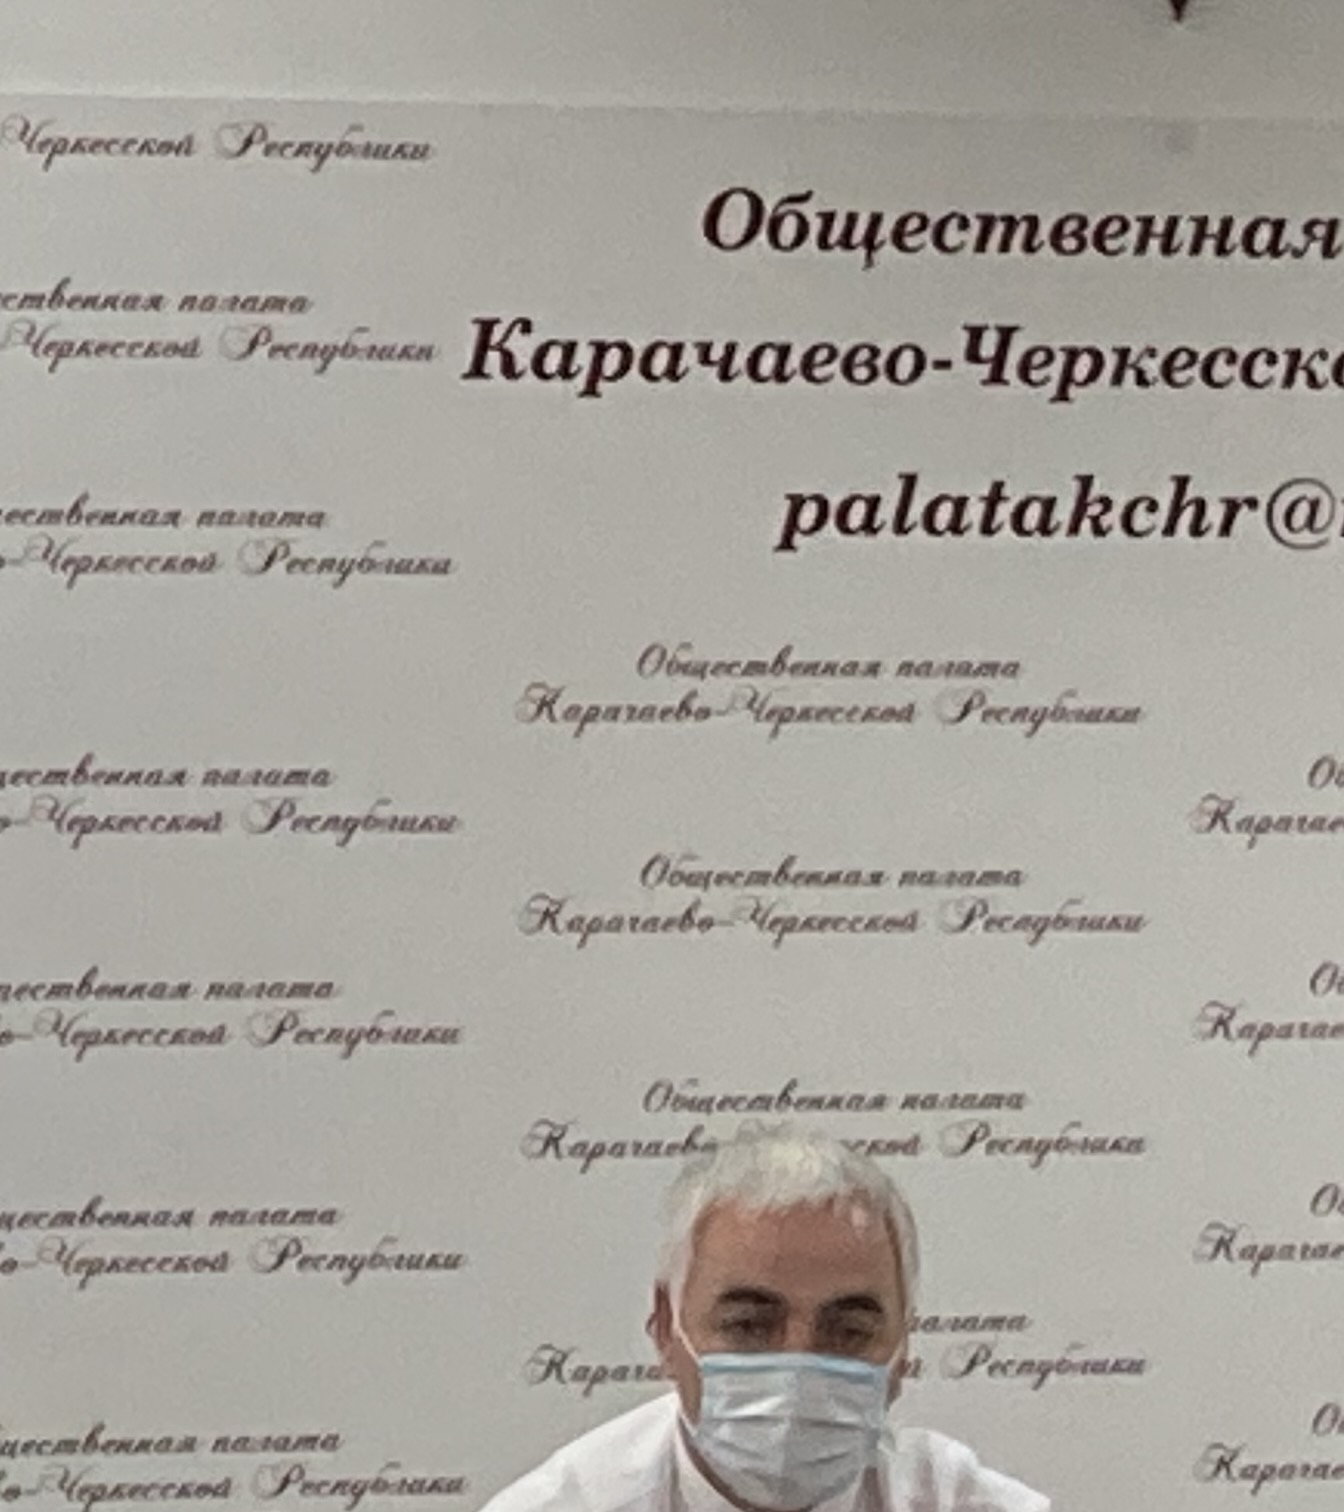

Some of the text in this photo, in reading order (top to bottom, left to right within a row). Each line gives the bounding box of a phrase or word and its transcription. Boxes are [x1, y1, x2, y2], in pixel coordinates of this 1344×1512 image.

[0, 115, 431, 174] Черкесской Республики
[702, 187, 1343, 271] Общественная
[0, 276, 314, 314] ственная палата
[0, 320, 435, 375] Черкесской Республики
[0, 491, 327, 529] ественная палата
[239, 538, 452, 589] Республики
[636, 642, 1021, 681] Общественная палата
[521, 682, 1145, 740] Карачаево-Черкесской Республики
[201, 769, 333, 787] палата
[249, 797, 462, 848] Республики
[640, 853, 1027, 892] Общественная палата
[520, 893, 1148, 950] Карачаево-Черкесской Республики
[204, 982, 340, 1000] палата
[248, 1009, 461, 1060] Республики
[643, 1078, 1028, 1116] Общественная палата
[944, 1120, 1146, 1169] Республики
[209, 1208, 343, 1227] палата
[255, 1236, 466, 1286] Республики
[948, 1342, 1147, 1391] Республики
[211, 1433, 344, 1453] палата
[260, 1462, 469, 1512] Республики
